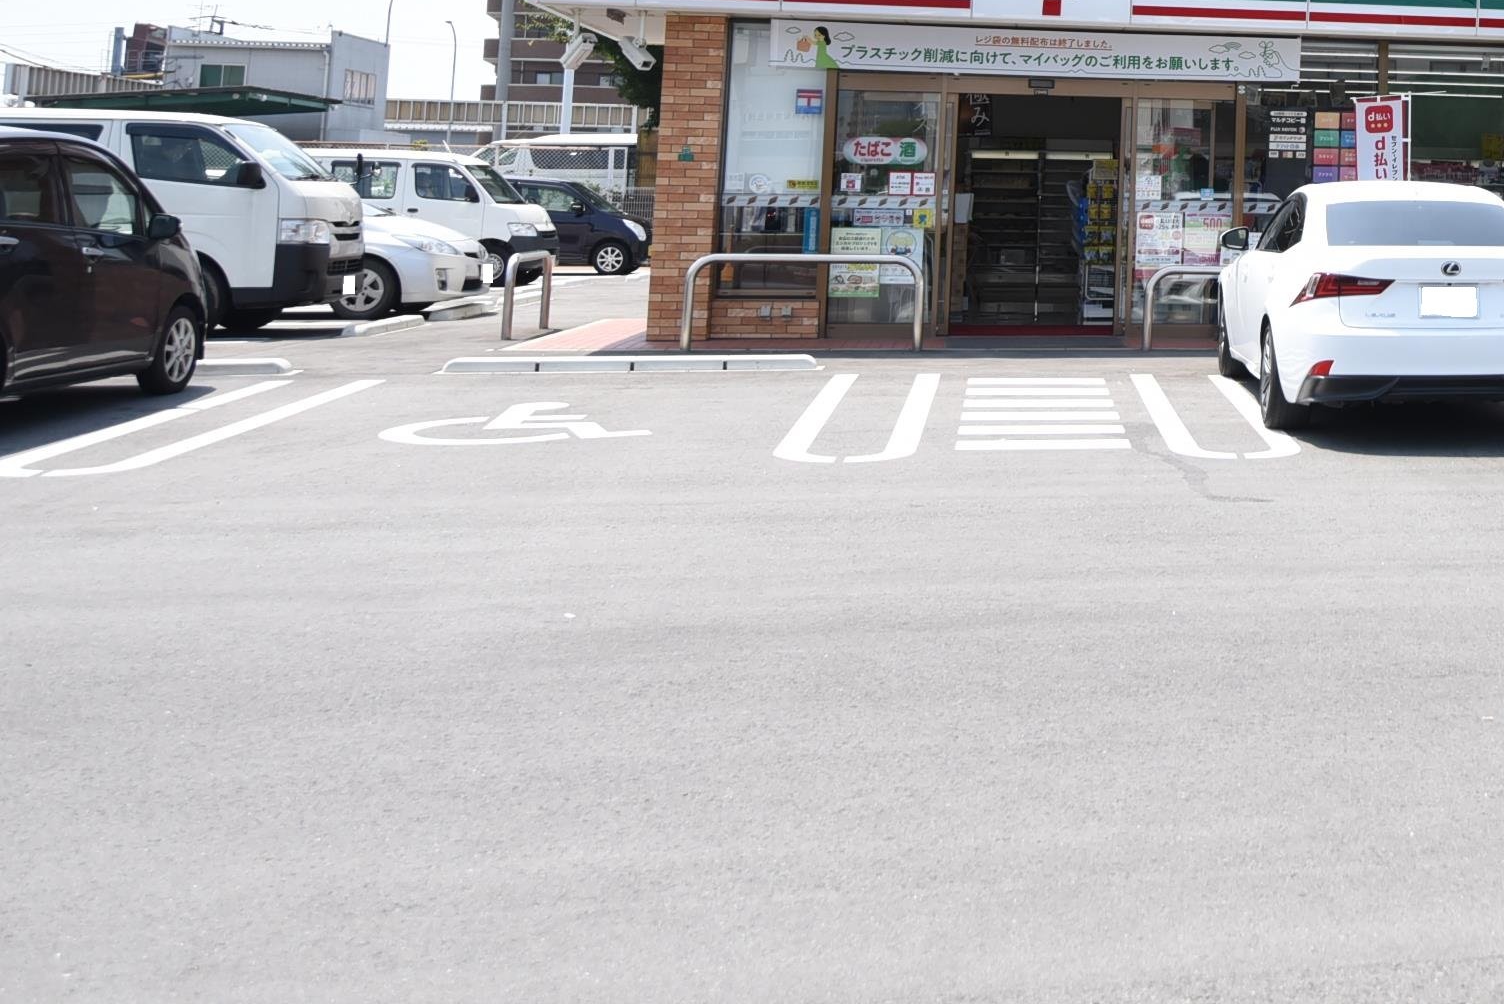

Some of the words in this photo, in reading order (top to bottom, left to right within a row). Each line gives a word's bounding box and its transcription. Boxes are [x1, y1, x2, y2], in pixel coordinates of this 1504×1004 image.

[975, 35, 1113, 49] レジ袋の無料配布は終了しました。
[840, 44, 1240, 72] プラスチック削減に向けて、マイバッグのご利用をお願いします。
[1367, 111, 1391, 121] d払い
[853, 140, 892, 157] たばこ
[899, 141, 917, 158] 酒
[1374, 136, 1388, 180] d払い
